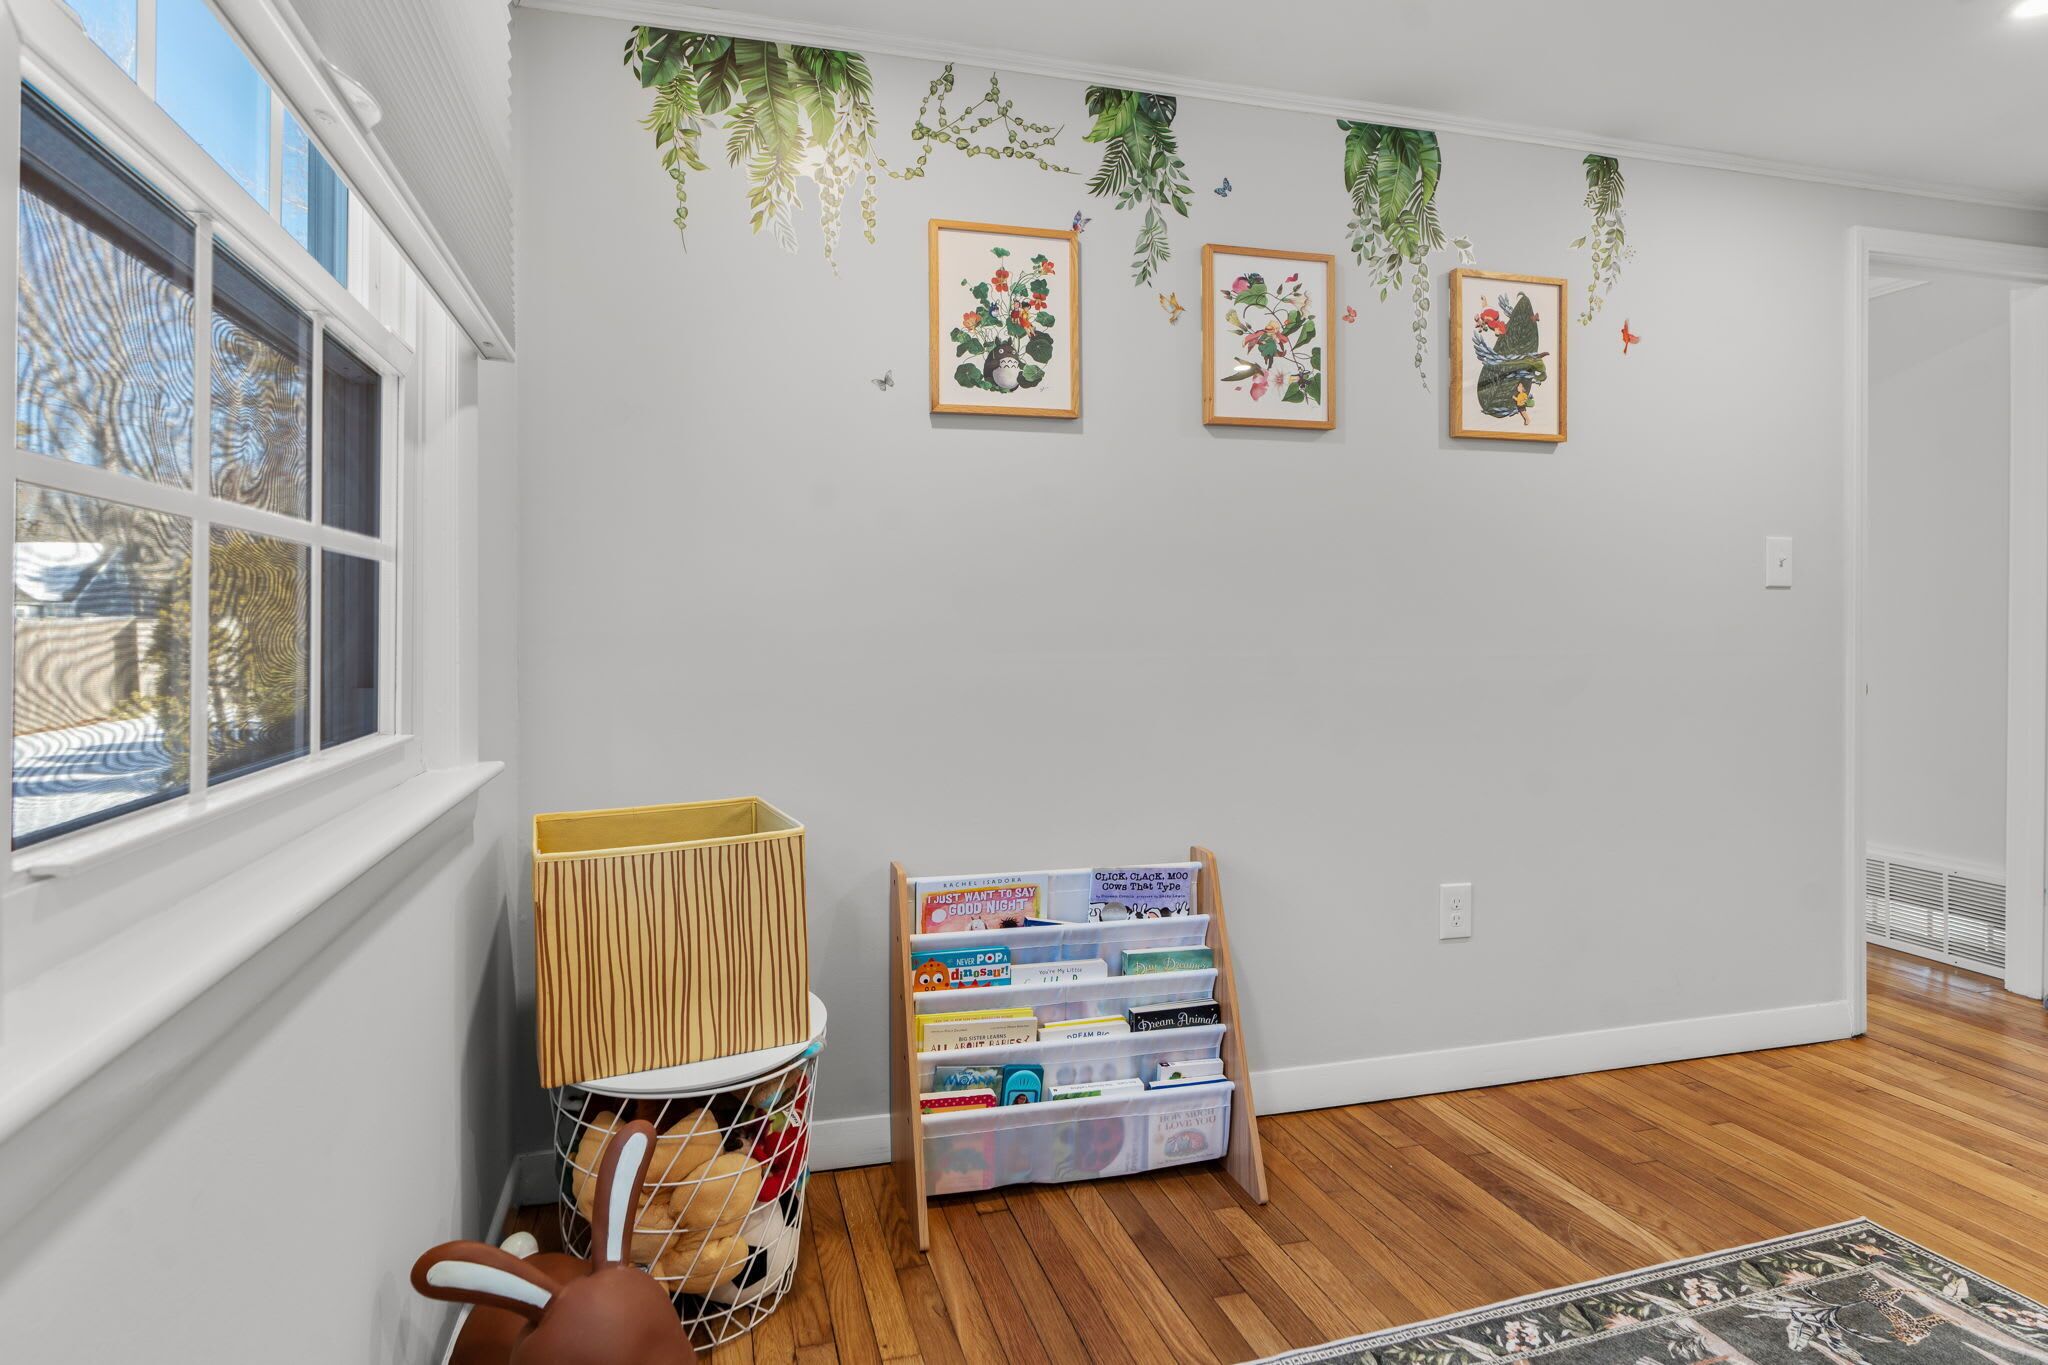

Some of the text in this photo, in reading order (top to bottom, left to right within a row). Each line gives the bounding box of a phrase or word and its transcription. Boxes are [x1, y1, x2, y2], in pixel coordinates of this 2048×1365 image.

[1095, 871, 1189, 882] CLICK, CLACK, MOO
[1102, 882, 1181, 893] Cows That Type
[933, 893, 961, 904] JUST
[964, 890, 996, 903] WANT
[1000, 889, 1012, 898] TO
[1015, 887, 1036, 898] SAY
[948, 898, 1029, 916] GOOD NIGHT
[956, 957, 975, 966] NEVER
[976, 952, 1003, 964] POP
[951, 965, 1009, 981] dinosaur!
[1137, 1017, 1175, 1032] Dream
